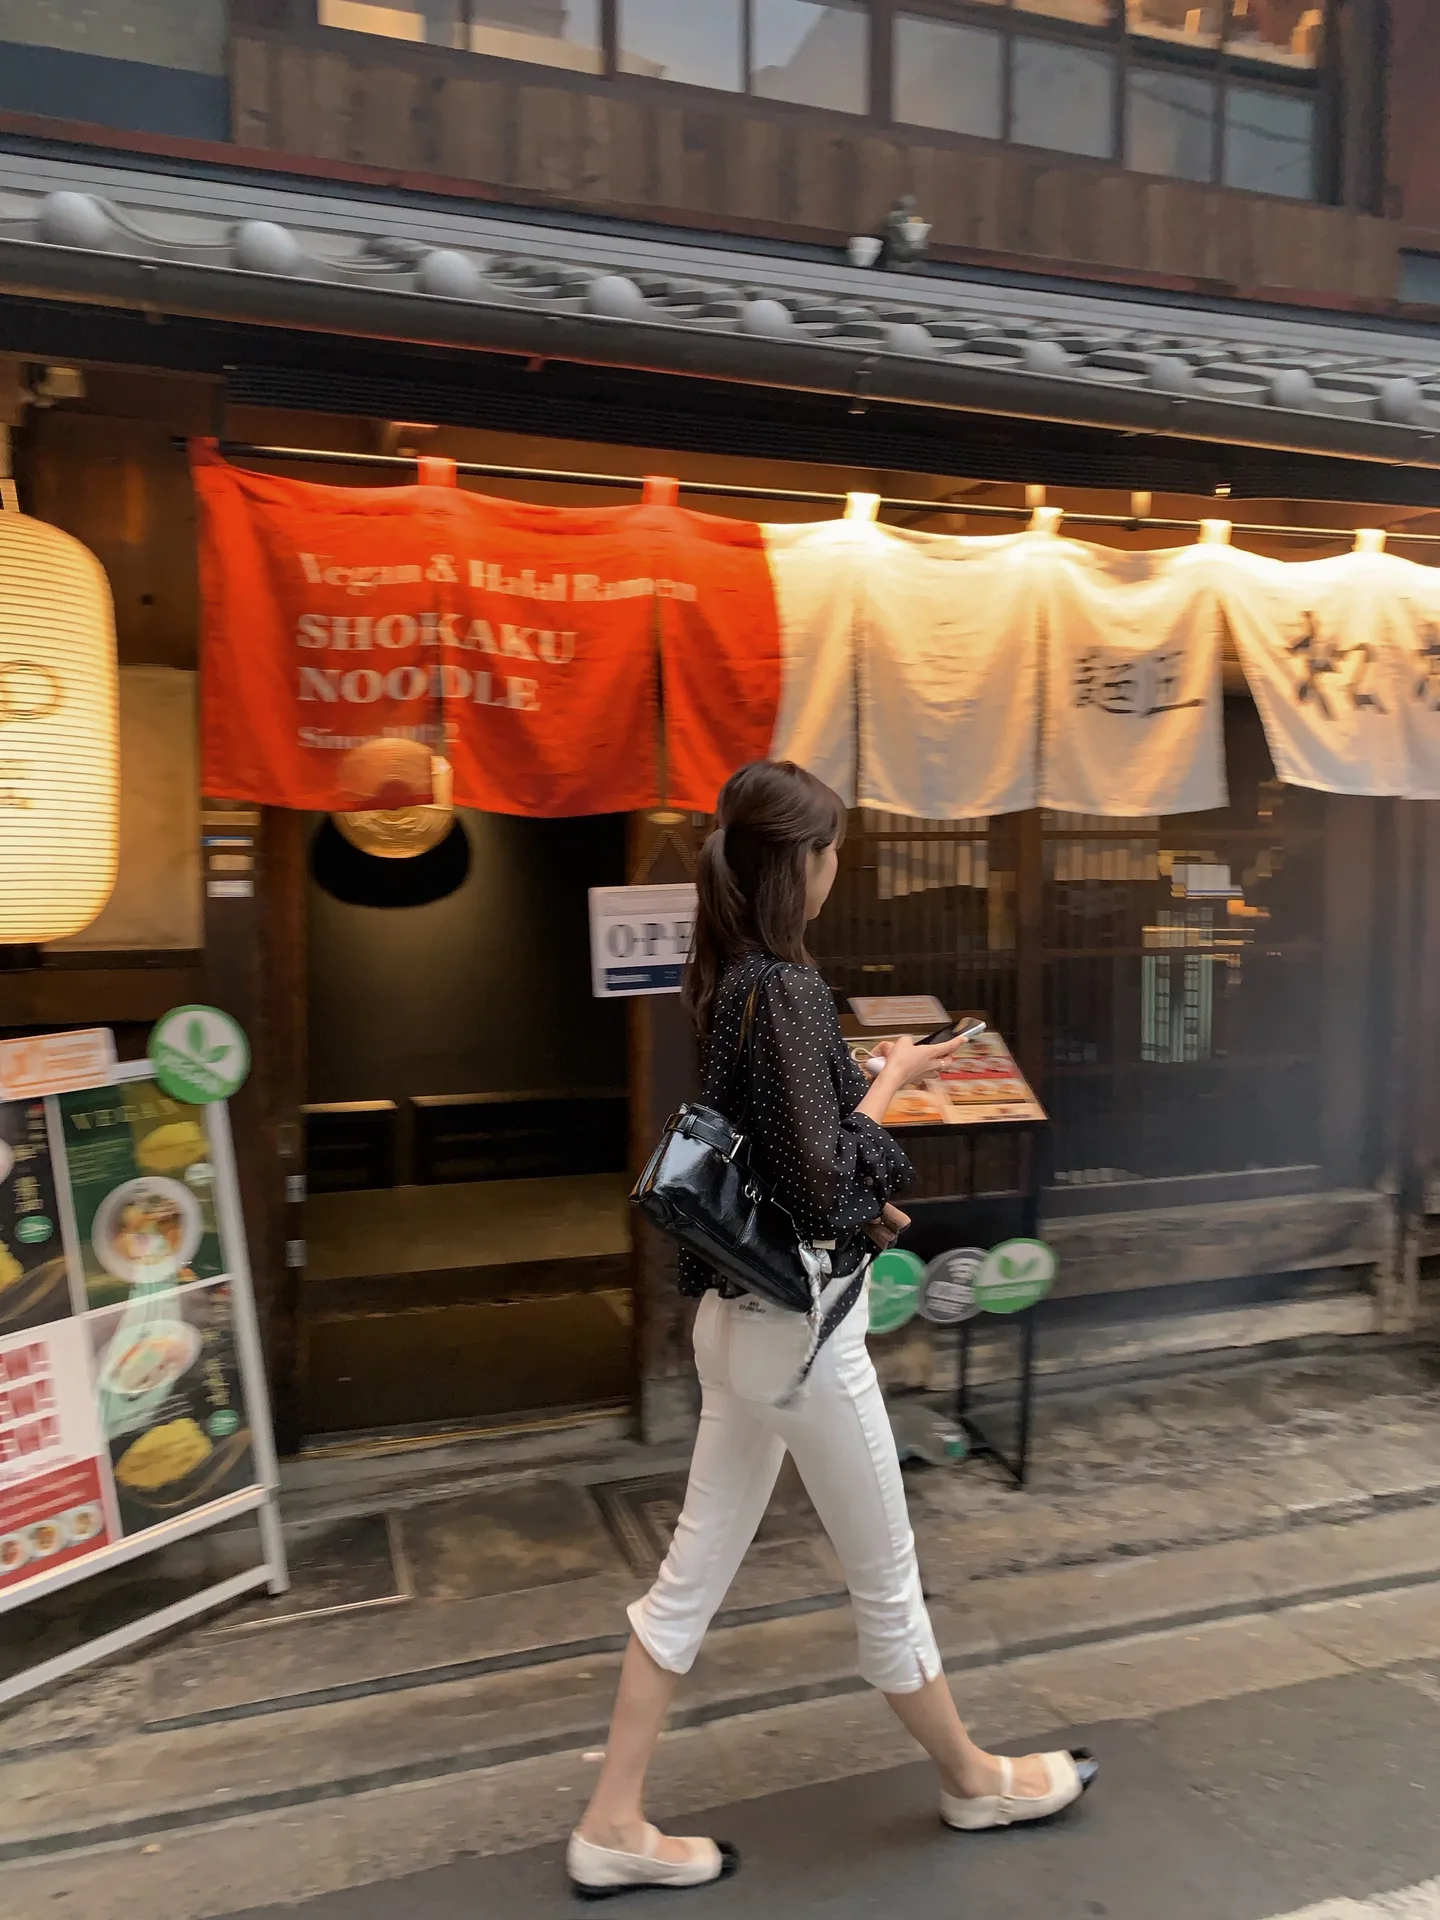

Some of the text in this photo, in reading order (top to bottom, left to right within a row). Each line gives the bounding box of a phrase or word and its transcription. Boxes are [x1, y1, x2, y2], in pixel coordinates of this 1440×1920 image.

[297, 552, 422, 595] Vegan
[425, 553, 459, 582] &
[467, 559, 567, 602] Halal
[297, 612, 578, 664] SHOKAKU
[297, 664, 542, 711] NOODLE
[605, 920, 694, 958] OPE
